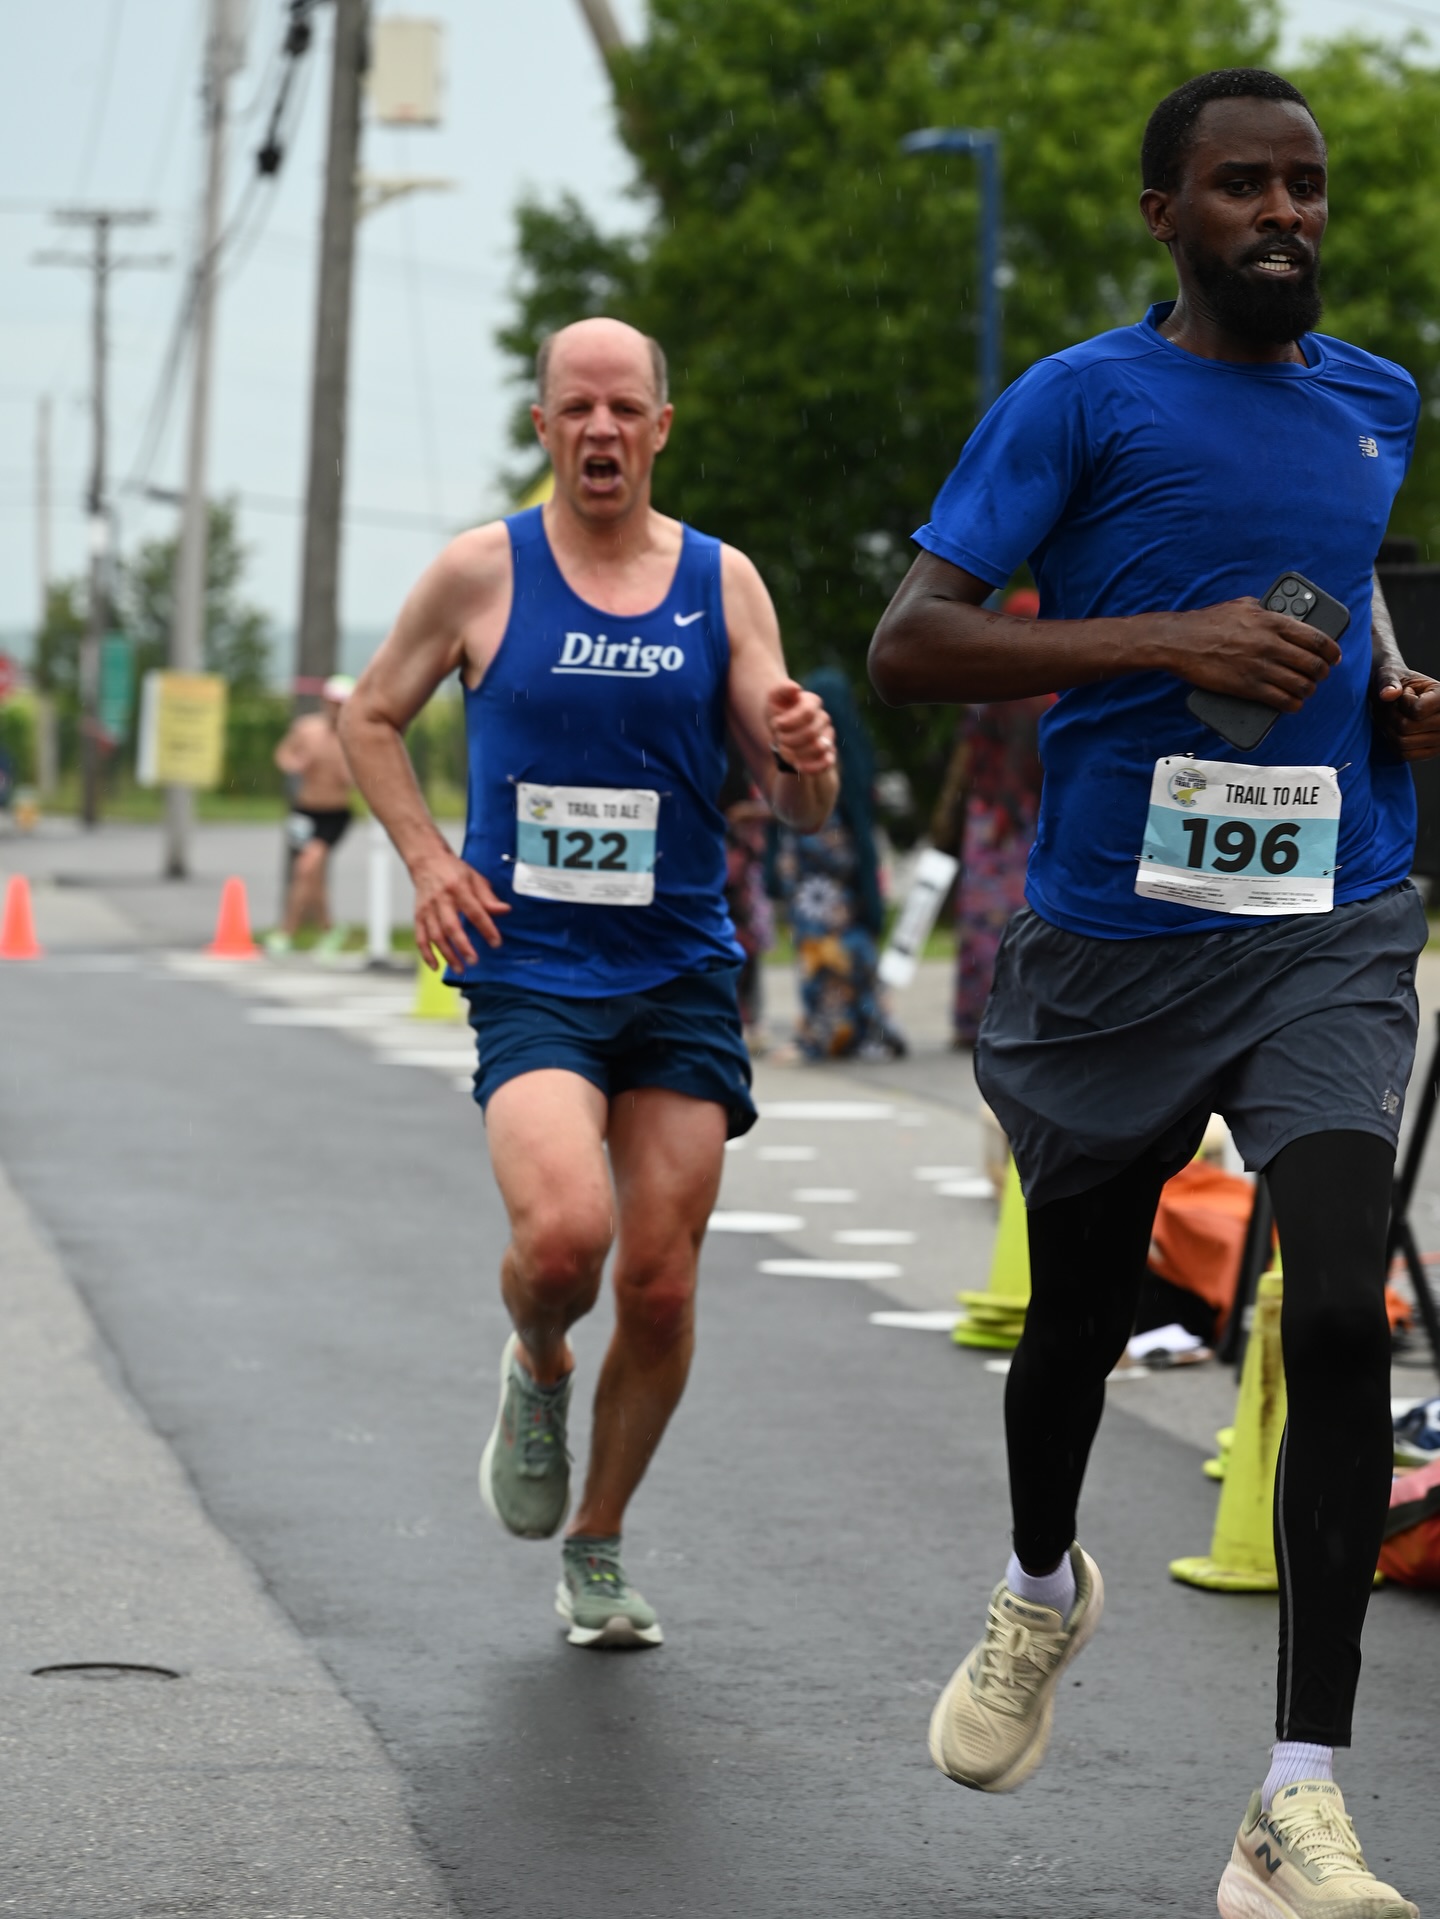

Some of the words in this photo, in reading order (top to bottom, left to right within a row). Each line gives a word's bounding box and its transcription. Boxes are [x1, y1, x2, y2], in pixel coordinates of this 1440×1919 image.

[551, 631, 685, 678] Dirigo
[567, 801, 599, 819] TRAIL
[603, 803, 617, 818] TO
[620, 804, 640, 819] ALE
[1225, 783, 1268, 805] TRAIL
[1273, 786, 1290, 805] TO
[1291, 786, 1320, 805] ALE
[541, 829, 628, 871] 122
[1182, 817, 1301, 875] 196
